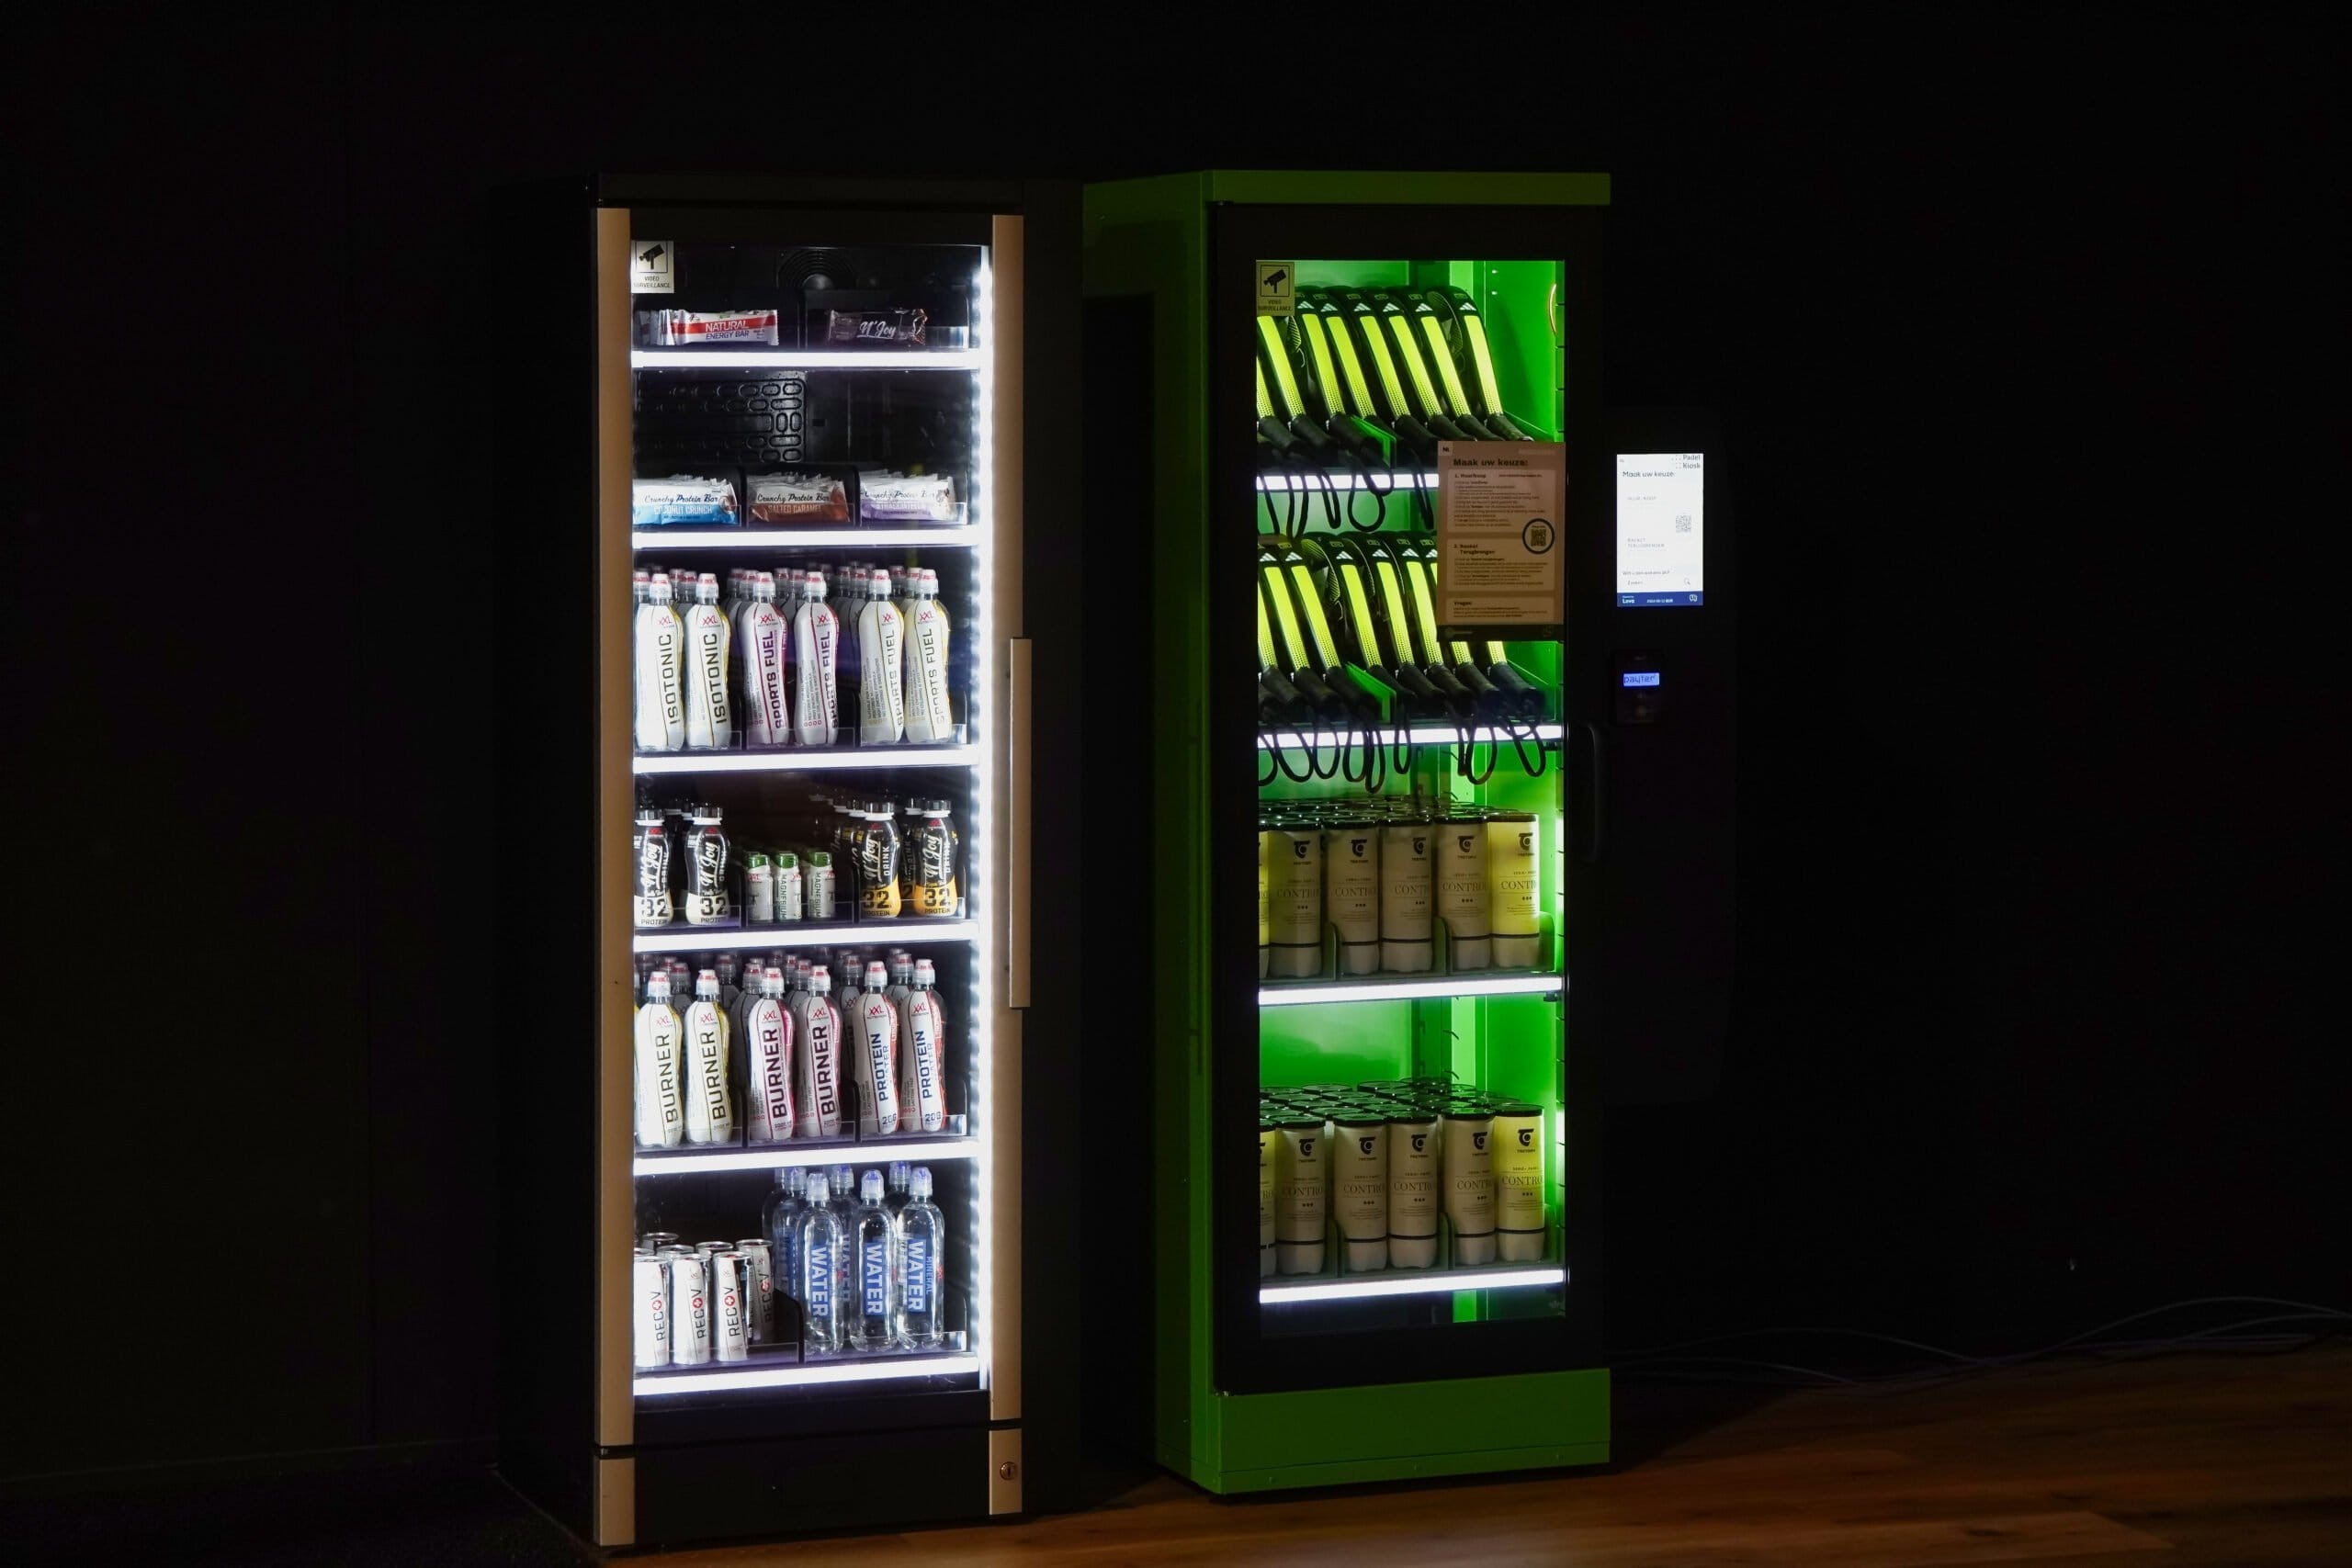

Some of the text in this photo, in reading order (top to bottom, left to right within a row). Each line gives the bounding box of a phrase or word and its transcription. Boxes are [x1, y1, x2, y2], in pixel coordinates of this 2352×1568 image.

[705, 320, 749, 332] NATURAL
[859, 320, 897, 338] N'Joy
[705, 332, 734, 340] ENERGY
[645, 494, 718, 505] Crunchy Protein Bar
[758, 493, 786, 503] Crunchy
[816, 493, 830, 501] Bar
[685, 505, 712, 514] CRUNCH
[768, 505, 791, 514] SALTED
[658, 615, 673, 625] XXL
[702, 615, 719, 626] XXL
[761, 614, 775, 624] XXL
[882, 613, 893, 622] XX
[919, 612, 933, 622] XXL
[763, 631, 775, 667] FUEL
[820, 631, 831, 667] FUEL
[658, 634, 679, 724] ISOTONIC
[703, 633, 727, 724] ISOTONIC
[887, 630, 904, 726] SPORTS FUEL
[922, 628, 944, 725] SPORTS FUEL
[1624, 676, 1655, 684] payter
[767, 671, 784, 729] SPORTS
[699, 841, 720, 888] N'Joy
[862, 838, 882, 882] N'Joy
[922, 835, 943, 880] N'Joy
[700, 897, 727, 916] 32
[864, 891, 890, 909] 32
[925, 888, 950, 907] 32
[641, 898, 669, 917] 32
[763, 1010, 778, 1021] XXL
[812, 1007, 826, 1018] XXL
[868, 1005, 884, 1015] XXL
[914, 1002, 926, 1013] XXL
[656, 1016, 670, 1027] XXL
[700, 1012, 715, 1023] XXL
[762, 1027, 788, 1119] BURNER
[812, 1025, 836, 1116] BURNER
[870, 1033, 889, 1102] PROTEIN
[914, 1030, 933, 1099] PROTEIN
[655, 1033, 679, 1123] BURNER
[700, 1031, 726, 1120] BURNER
[882, 1113, 897, 1125] 20G
[925, 1111, 941, 1122] 20G
[811, 1247, 828, 1317] WATER
[866, 1244, 883, 1314] WATER
[908, 1241, 924, 1310] WATER
[650, 1291, 665, 1341] RECOV
[691, 1288, 706, 1339] RECOV
[724, 1287, 741, 1337] RECOV
